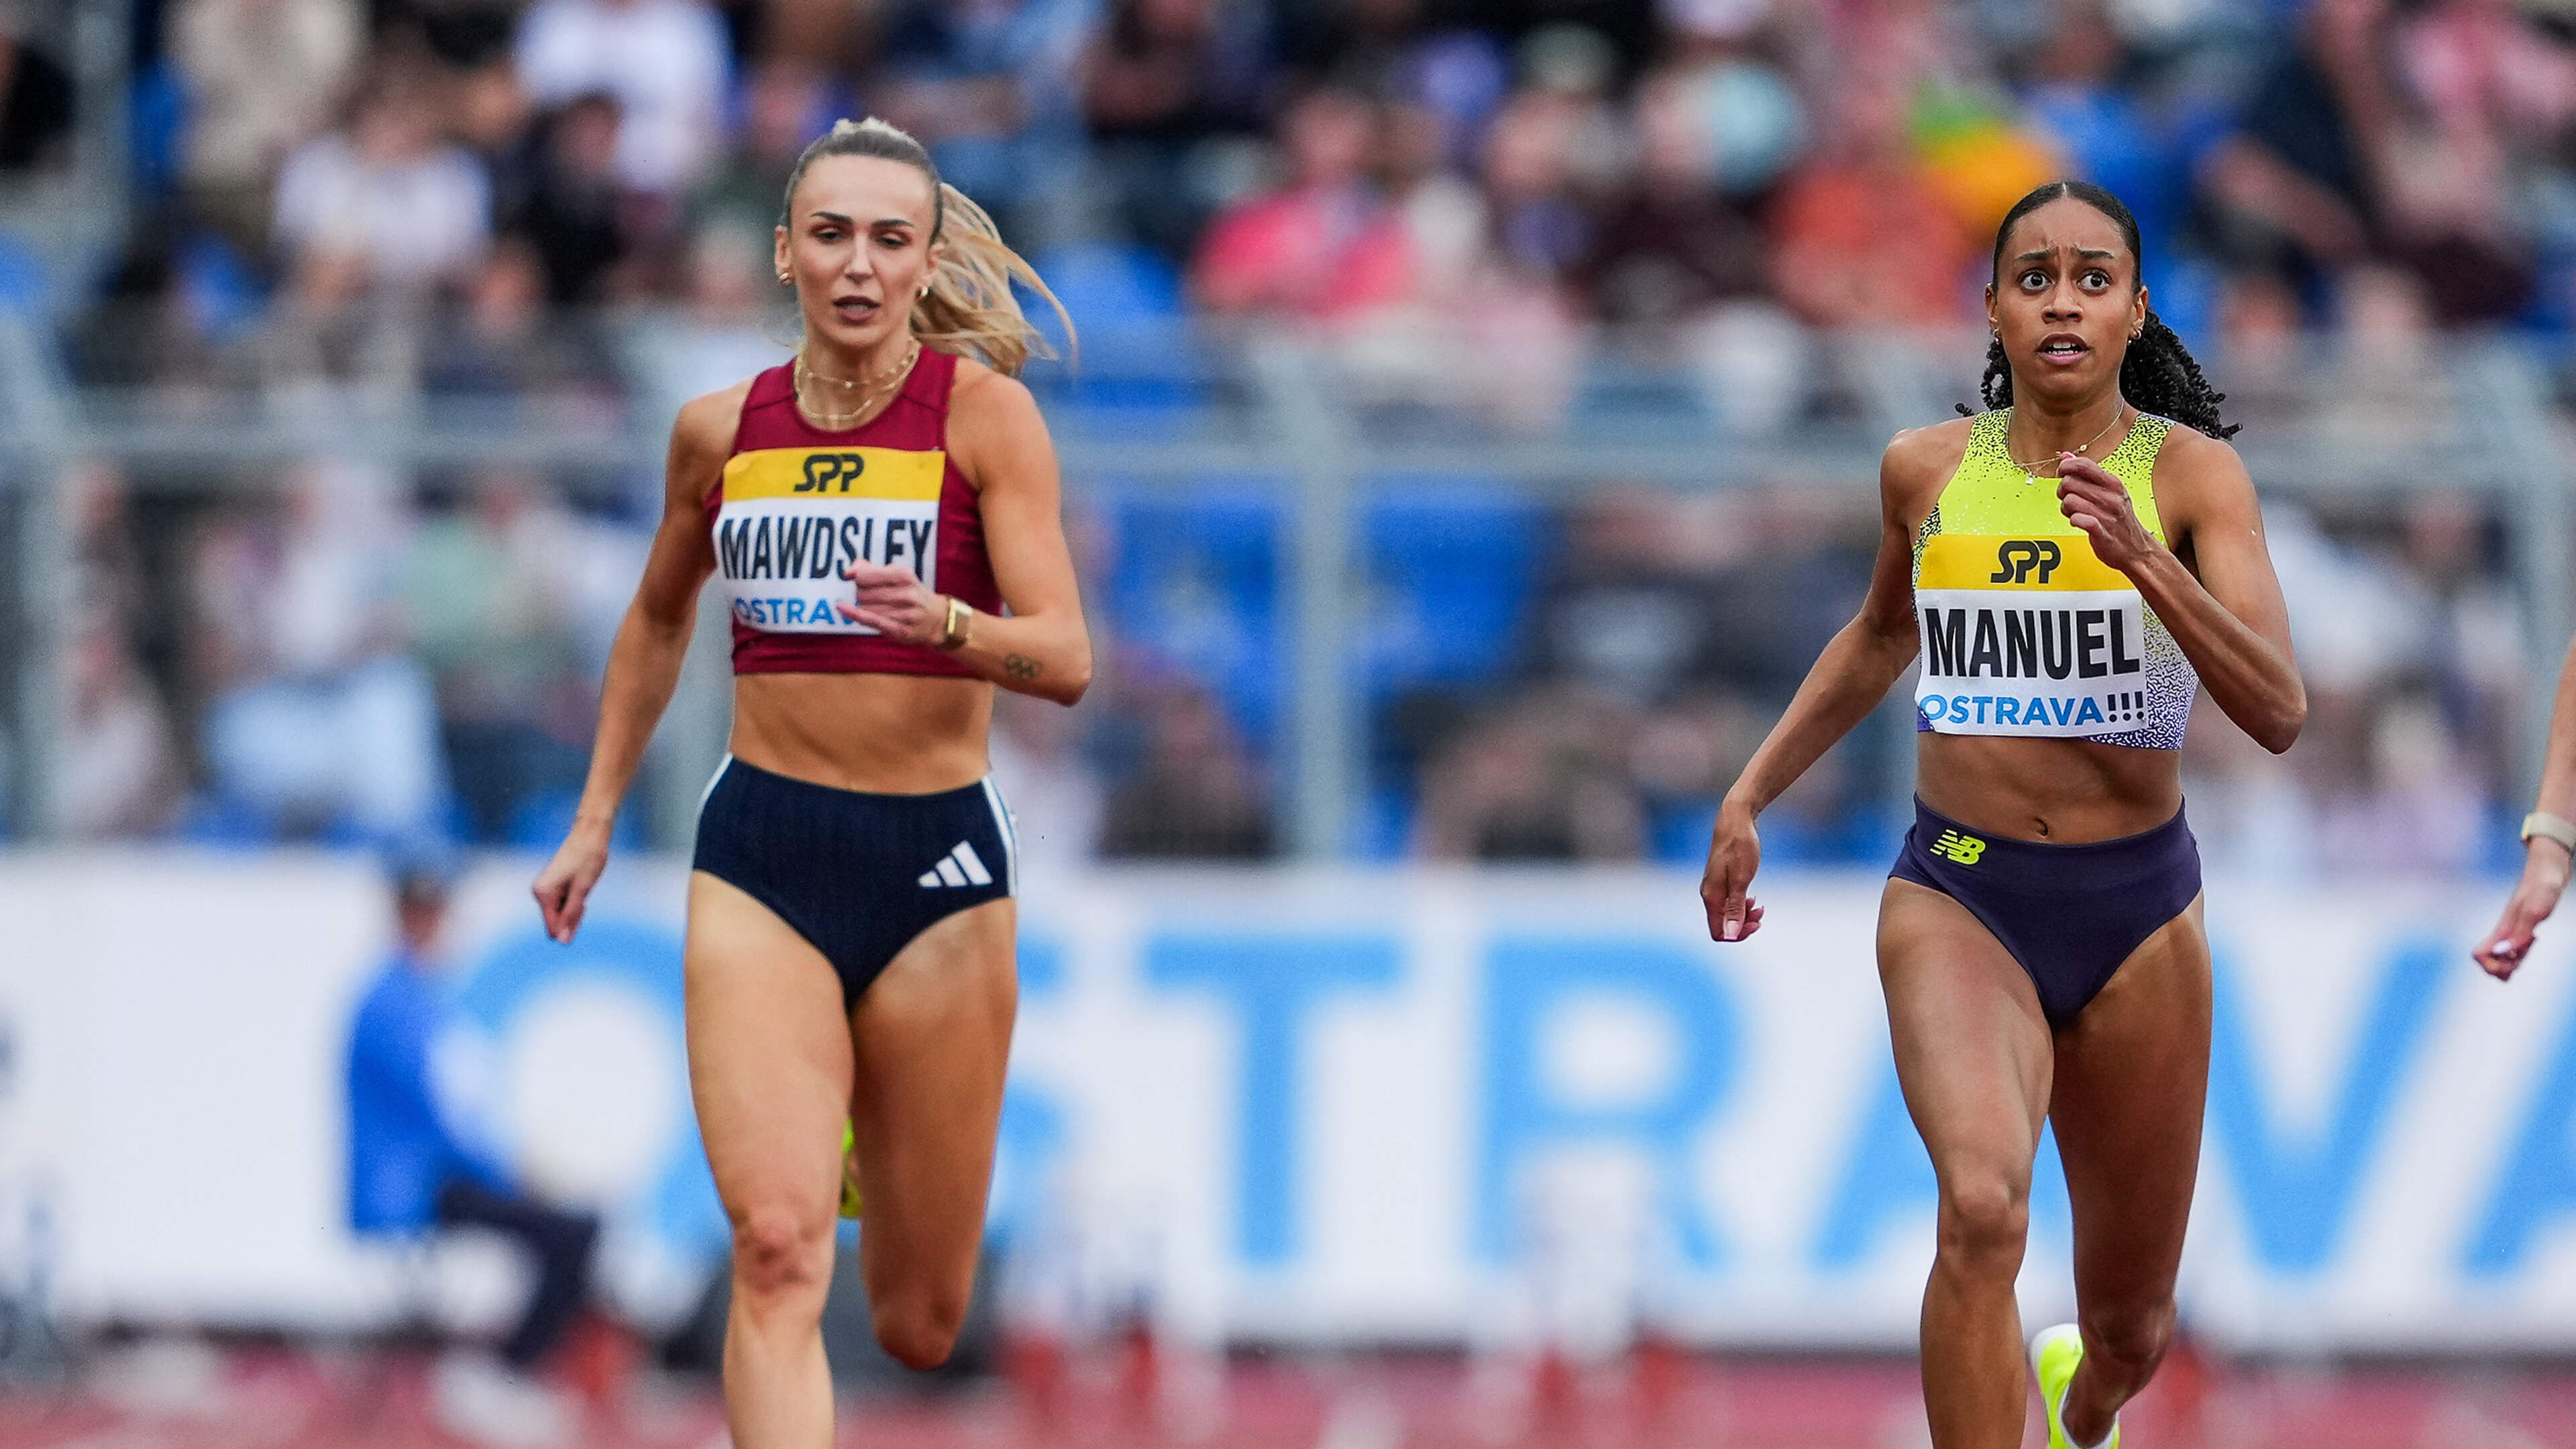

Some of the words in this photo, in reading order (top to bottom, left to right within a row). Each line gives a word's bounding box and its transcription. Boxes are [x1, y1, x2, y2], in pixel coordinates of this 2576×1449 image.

[794, 453, 865, 492] SPP
[1990, 540, 2061, 584] SPP
[1925, 608, 2140, 680] MANUEL
[1919, 691, 2144, 726] OSTRAVA!!!
